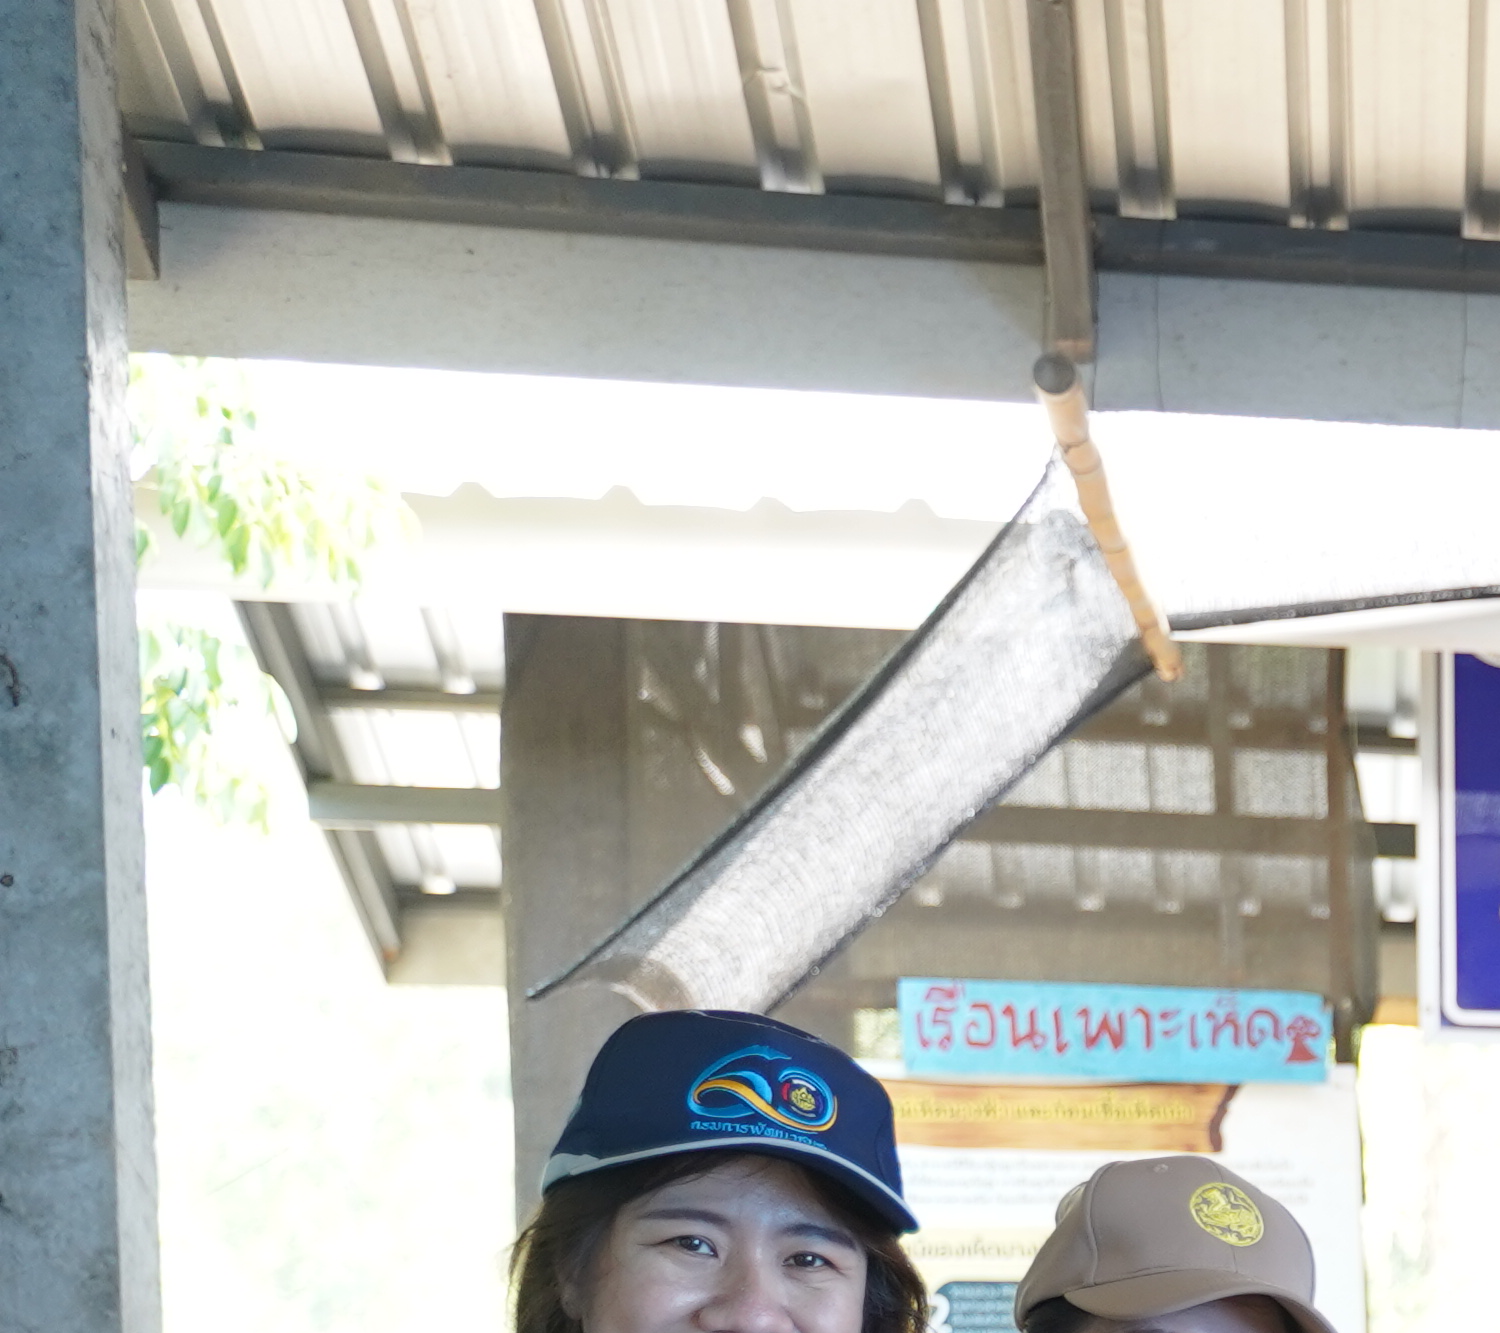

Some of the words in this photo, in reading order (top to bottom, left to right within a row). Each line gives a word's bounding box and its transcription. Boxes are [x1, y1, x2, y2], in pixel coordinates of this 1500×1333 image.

[914, 978, 1282, 1057] เรือนเพาะเห็ด
